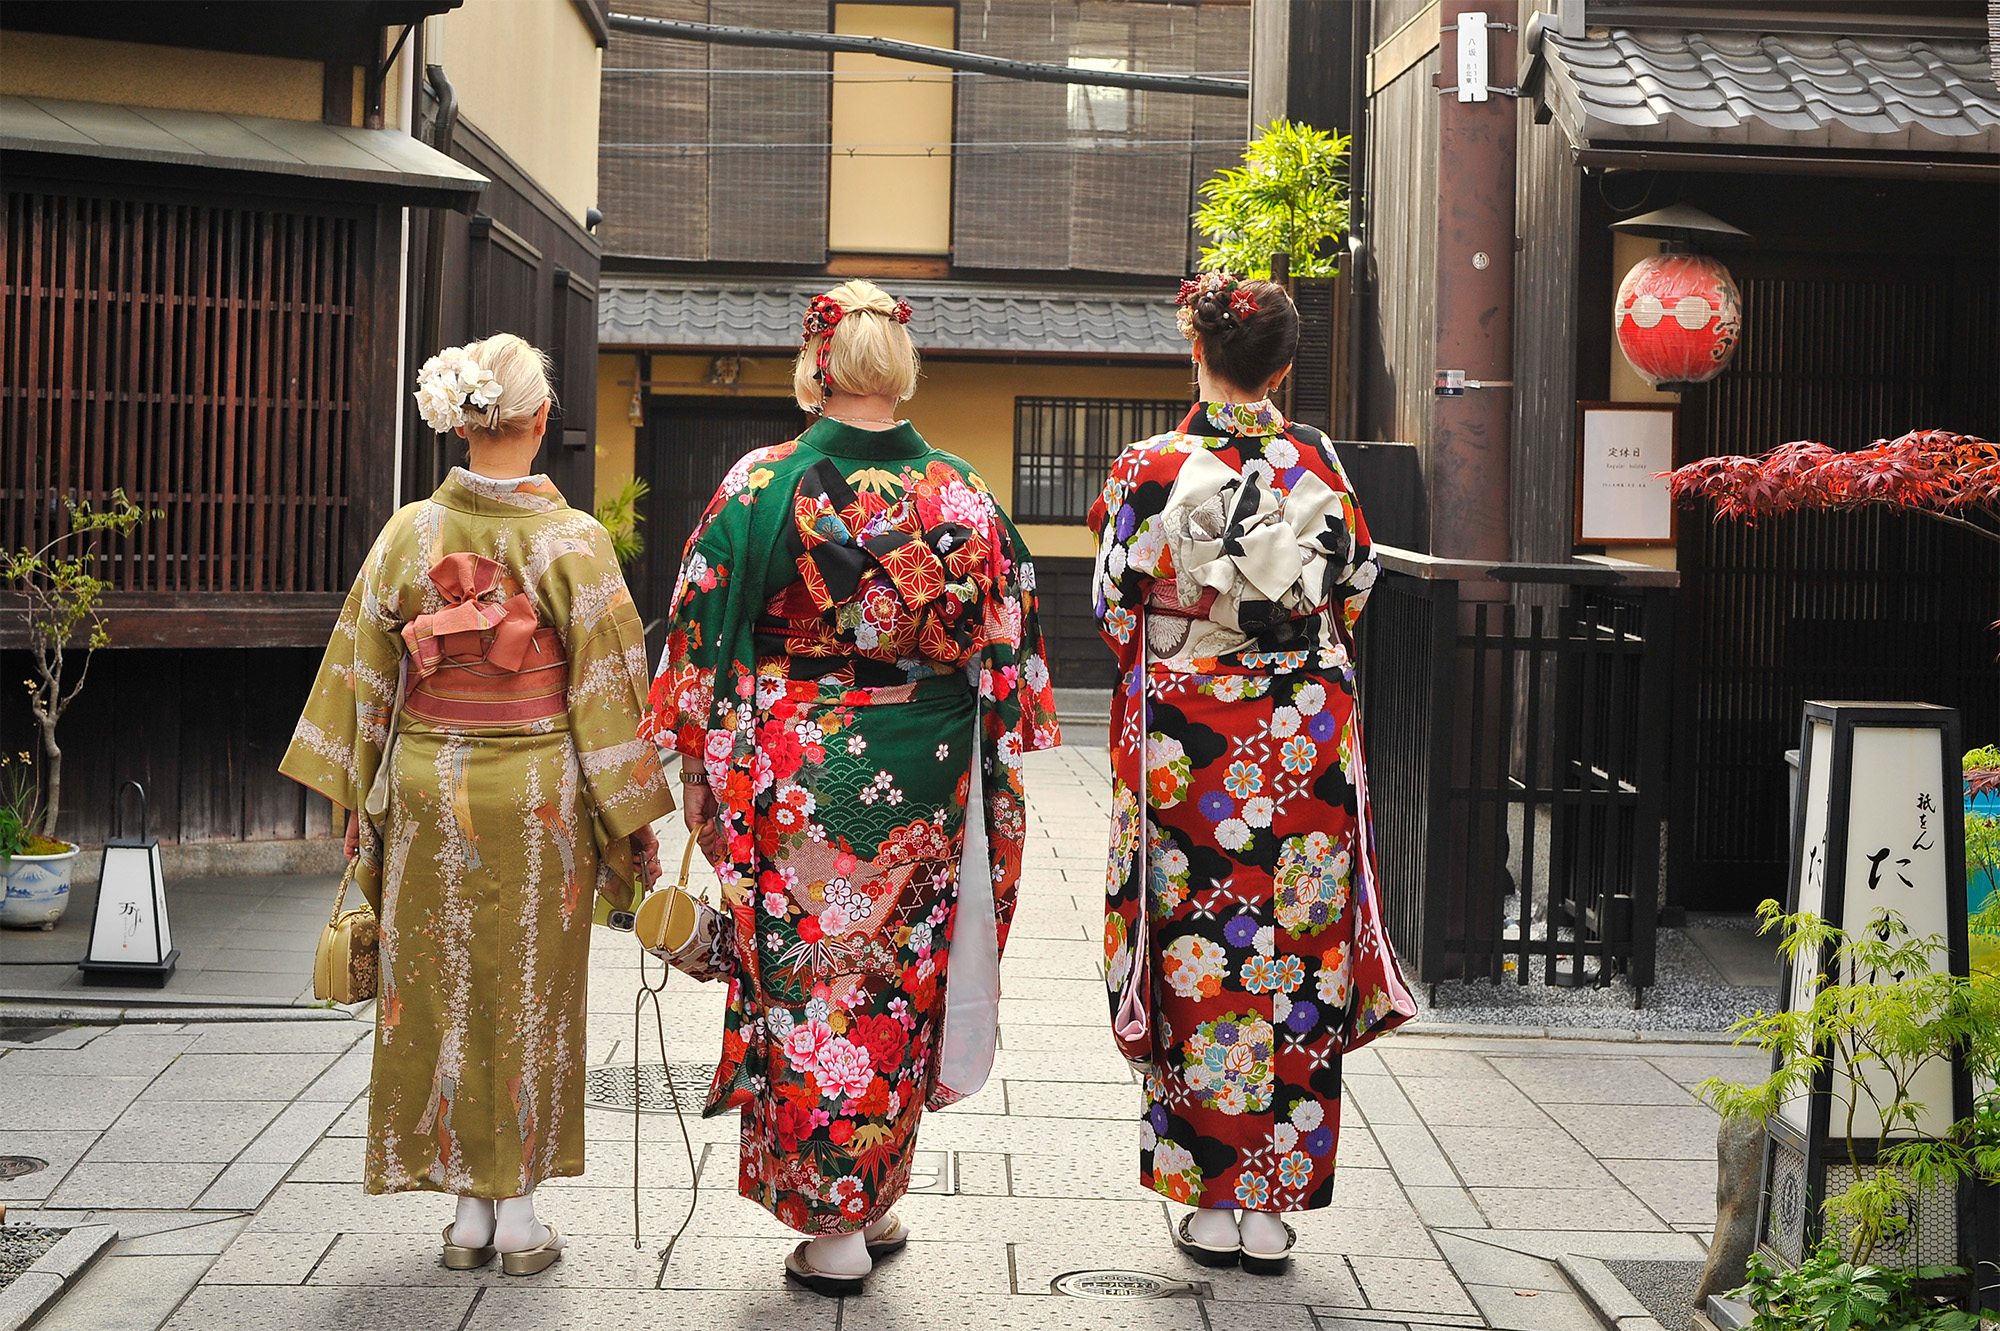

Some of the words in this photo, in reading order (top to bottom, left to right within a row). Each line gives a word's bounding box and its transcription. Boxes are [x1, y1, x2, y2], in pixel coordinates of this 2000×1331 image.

[1608, 447, 1640, 458] 定休日
[1912, 792, 1936, 850] 祇をん
